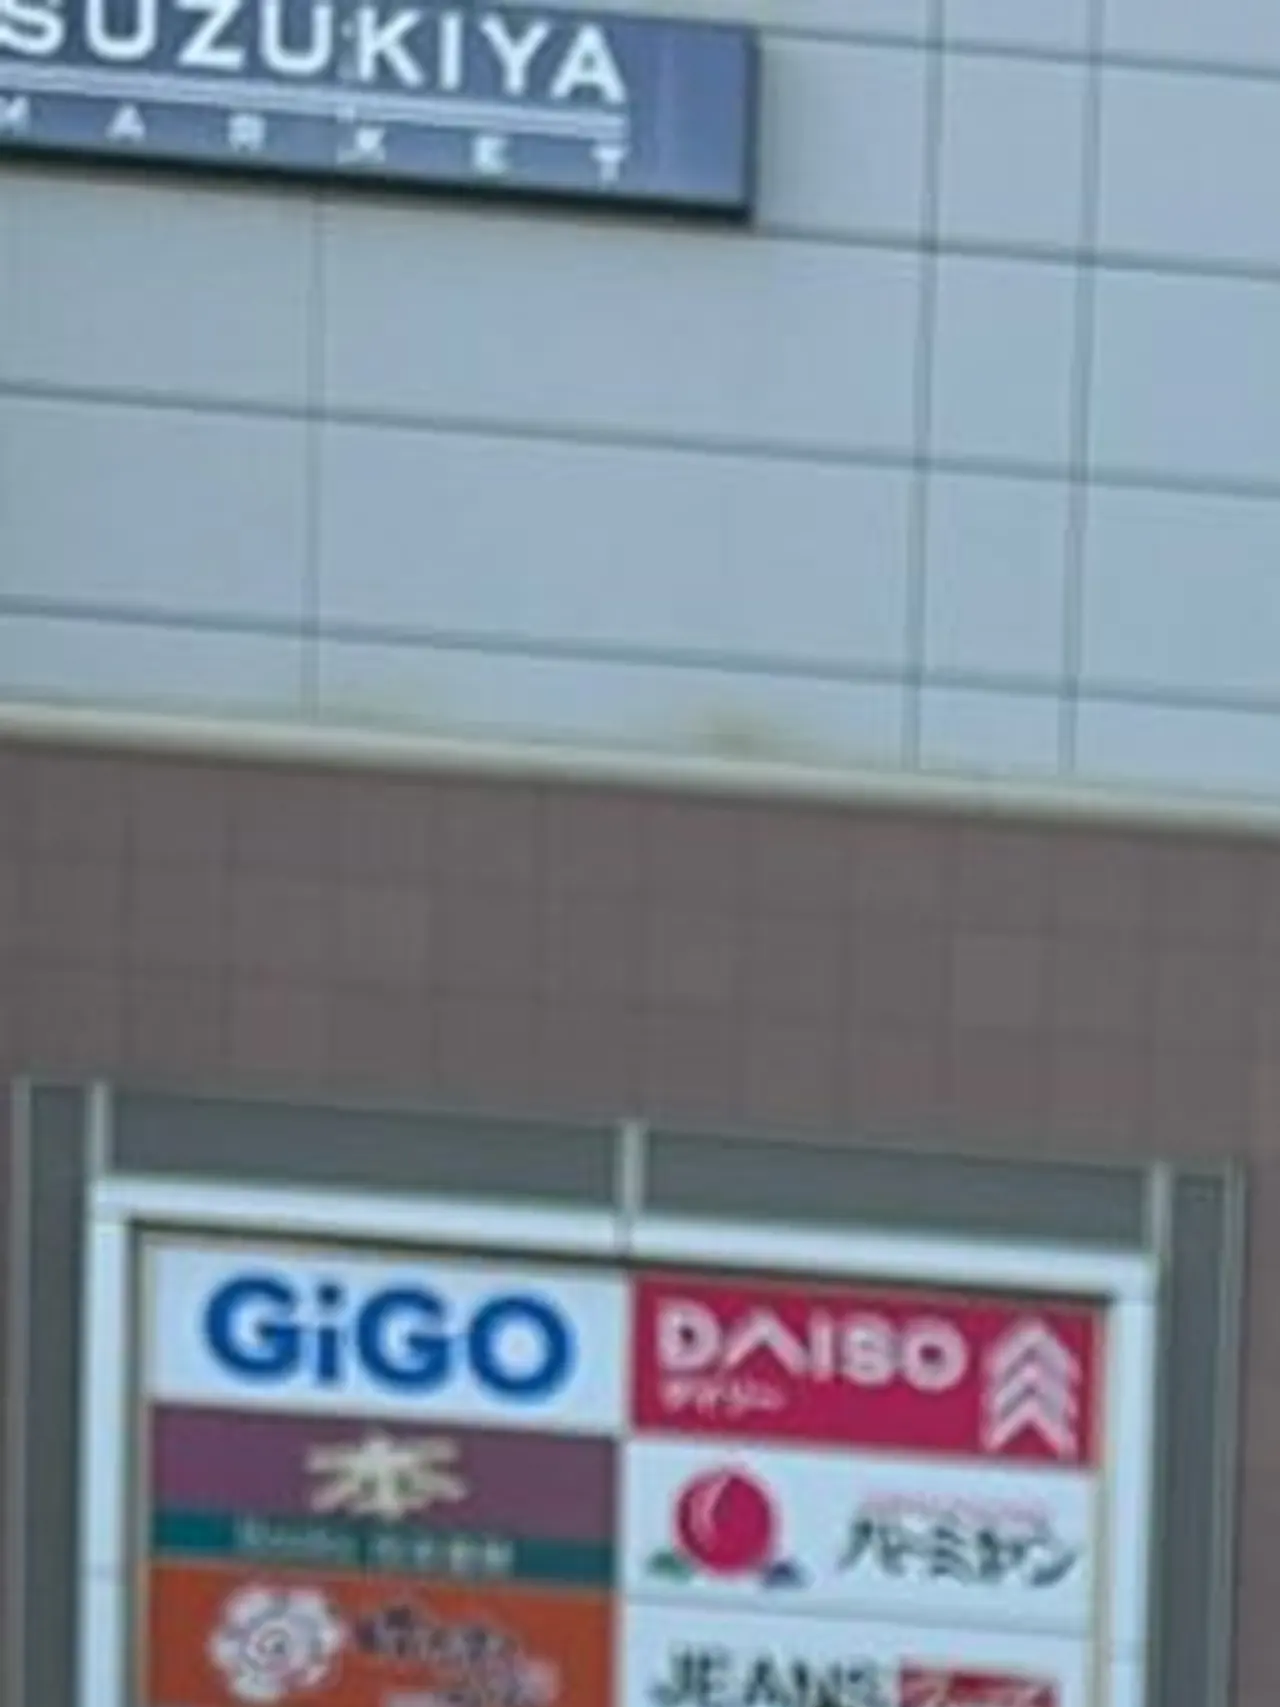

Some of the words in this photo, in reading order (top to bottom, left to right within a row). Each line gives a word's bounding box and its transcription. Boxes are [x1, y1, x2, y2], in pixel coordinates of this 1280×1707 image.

[0, 0, 626, 101] SUZUKIYA
[205, 1274, 573, 1403] GiGO
[656, 1299, 968, 1392] DAISO
